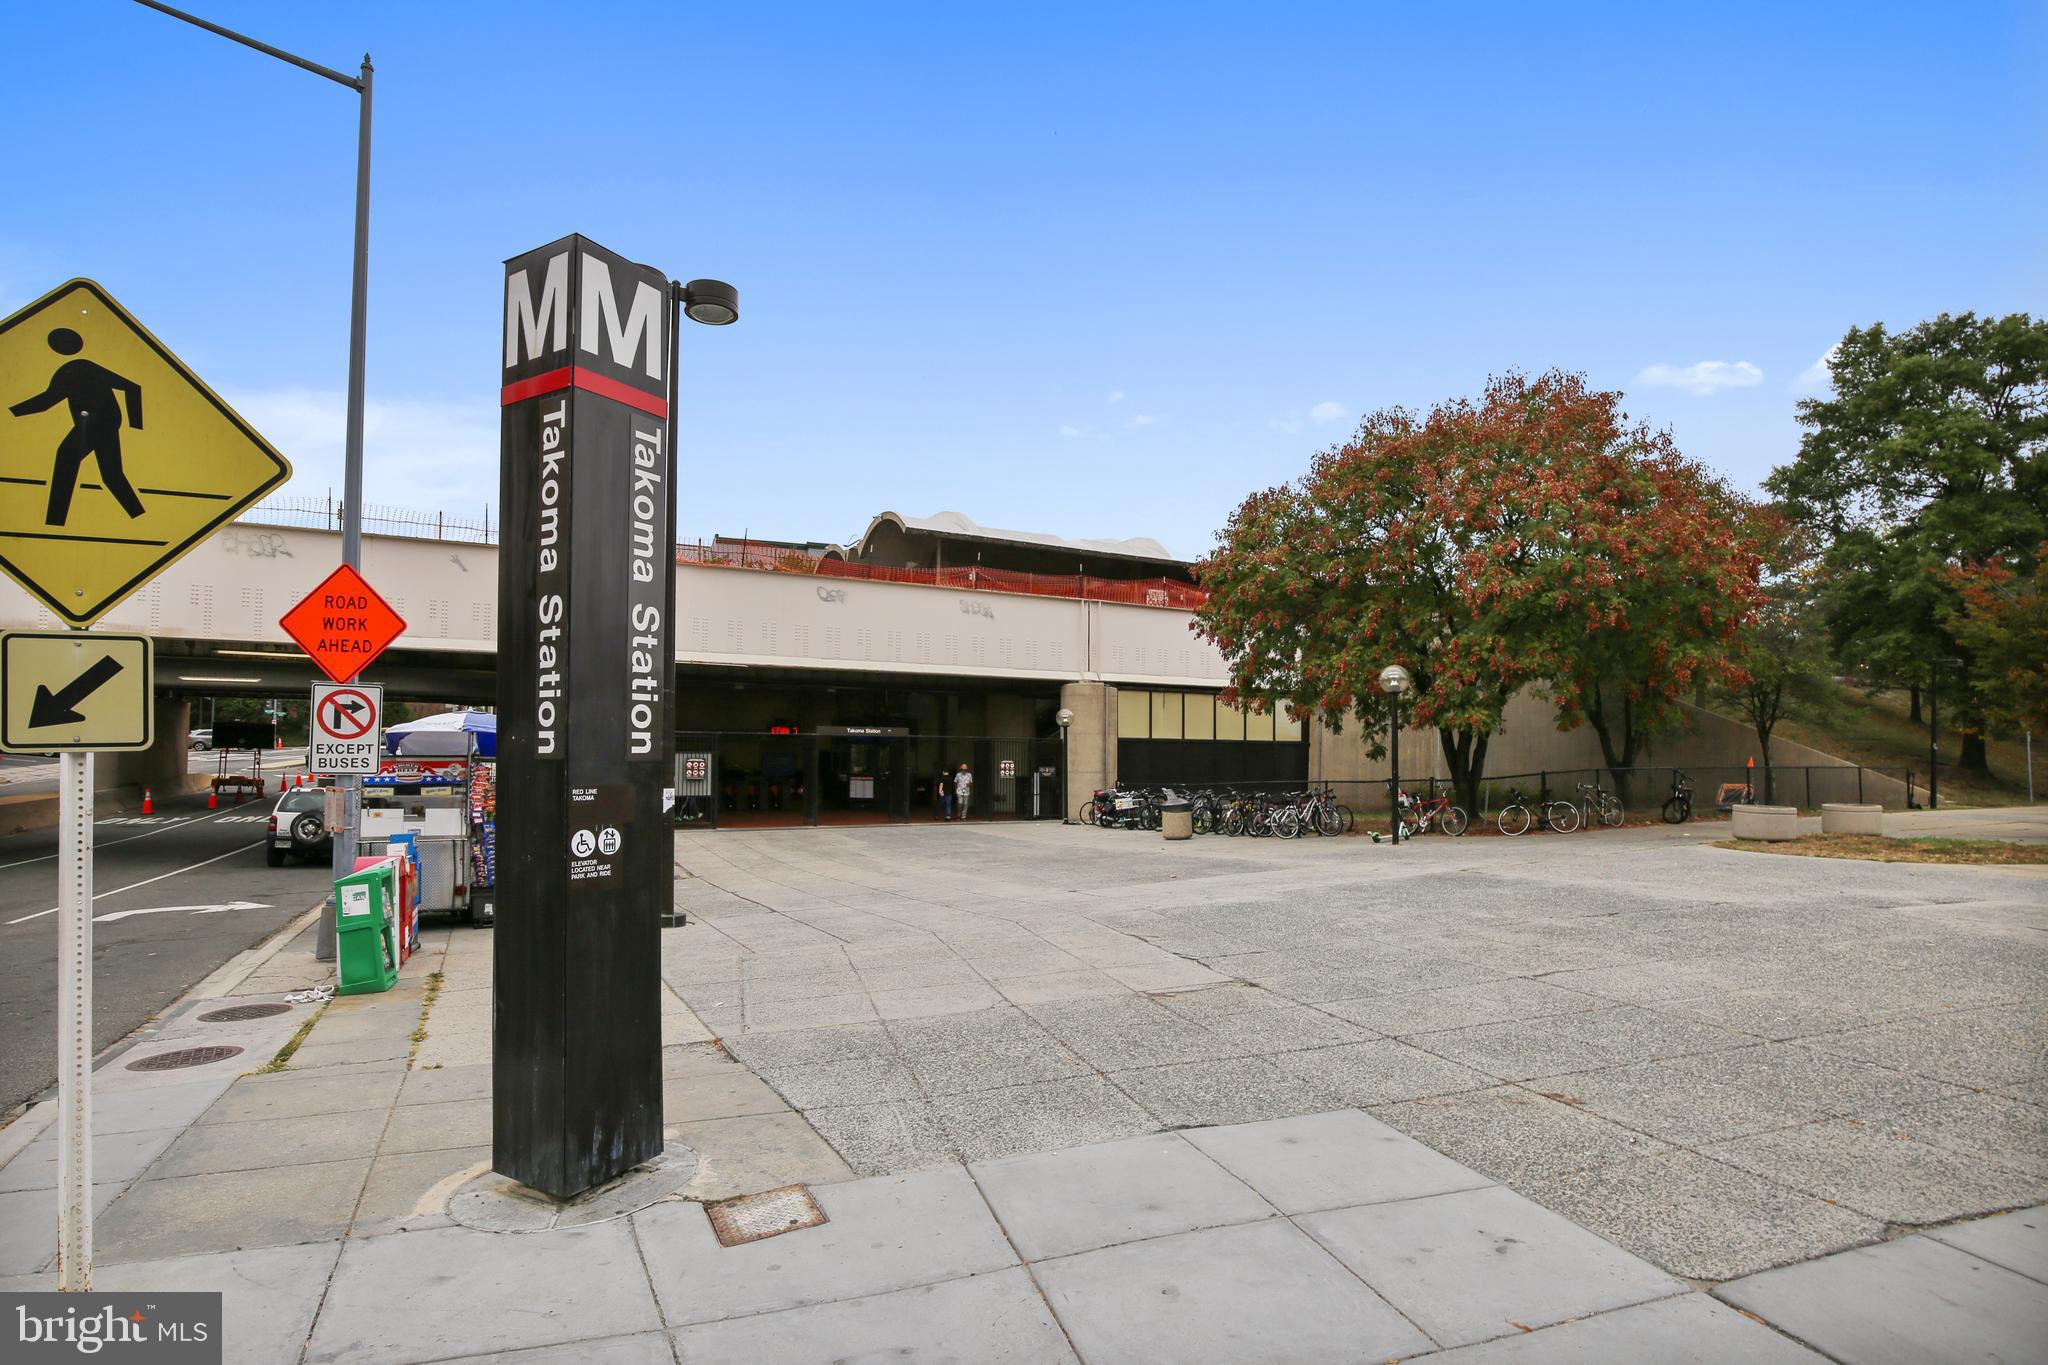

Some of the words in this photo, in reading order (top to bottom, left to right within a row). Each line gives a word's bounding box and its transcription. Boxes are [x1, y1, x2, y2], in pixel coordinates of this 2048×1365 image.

[506, 251, 568, 369] M
[580, 252, 662, 381] M
[540, 399, 566, 573] Takoma
[633, 428, 662, 583] Takoma
[324, 595, 368, 610] ROAD
[322, 616, 368, 632] WORK
[316, 638, 373, 654] AHEAD
[537, 594, 563, 754] Station
[630, 603, 660, 754] Station
[316, 743, 374, 755] EXCEPT
[318, 757, 370, 769] BUSES
[93, 816, 192, 825] ONLY
[213, 815, 272, 823] ONL
